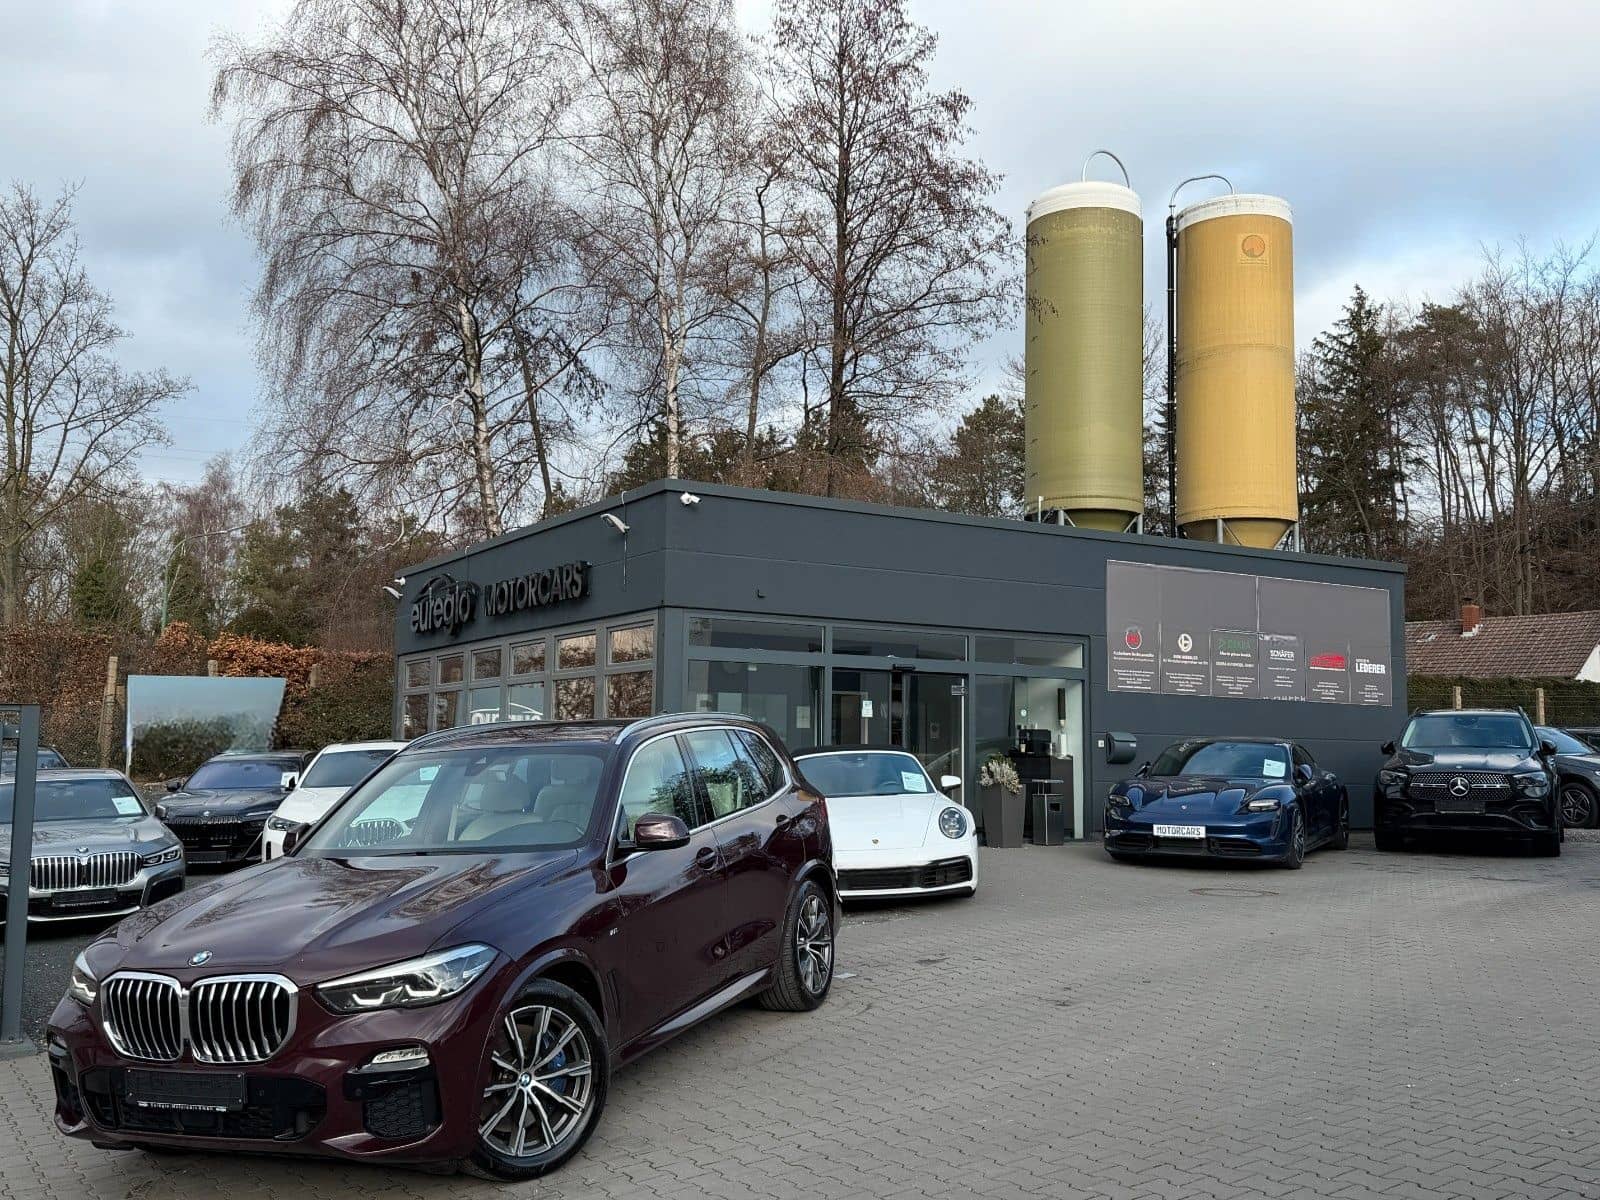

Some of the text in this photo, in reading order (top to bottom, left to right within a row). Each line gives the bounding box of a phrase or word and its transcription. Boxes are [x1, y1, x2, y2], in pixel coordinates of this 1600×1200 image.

[410, 562, 584, 633] euregio MOTORCARS
[1355, 662, 1386, 674] LEDERER
[1156, 826, 1201, 836] MOTORCARS
